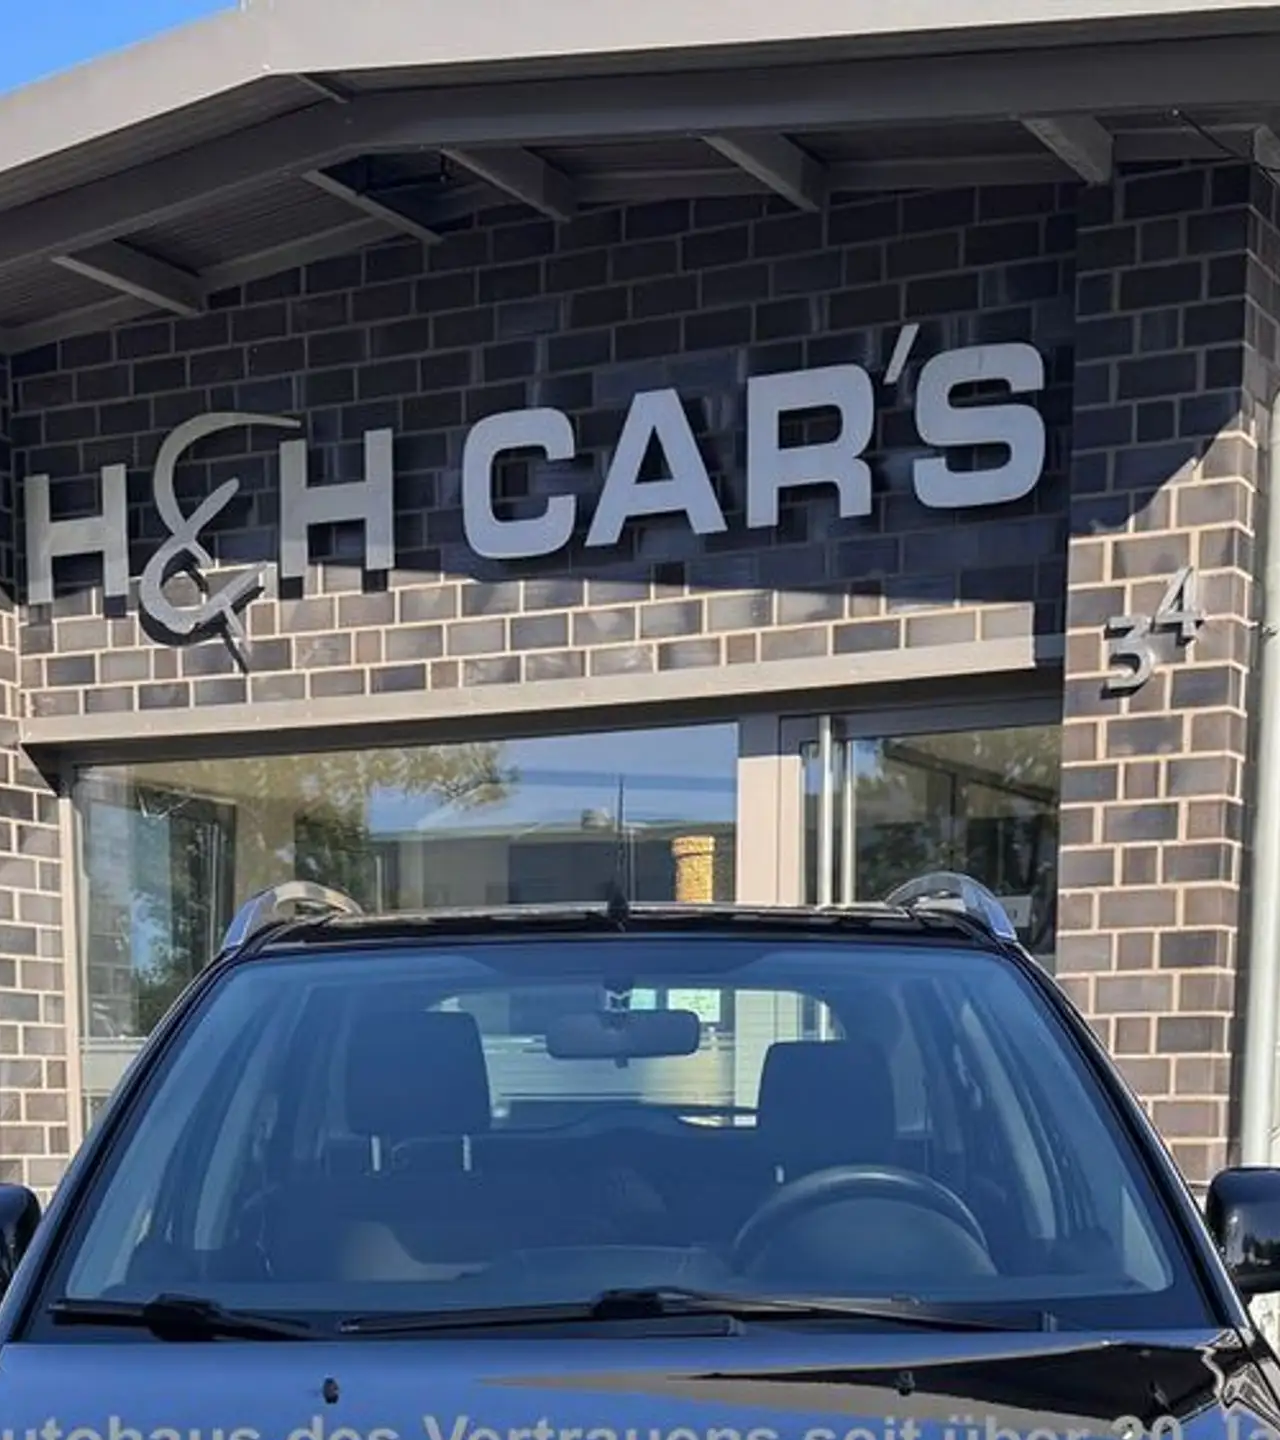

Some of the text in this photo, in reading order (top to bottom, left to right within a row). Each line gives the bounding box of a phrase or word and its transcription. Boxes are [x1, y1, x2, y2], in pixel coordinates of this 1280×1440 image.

[25, 325, 1046, 671] H&H CAR'S
[1107, 566, 1204, 690] 34
